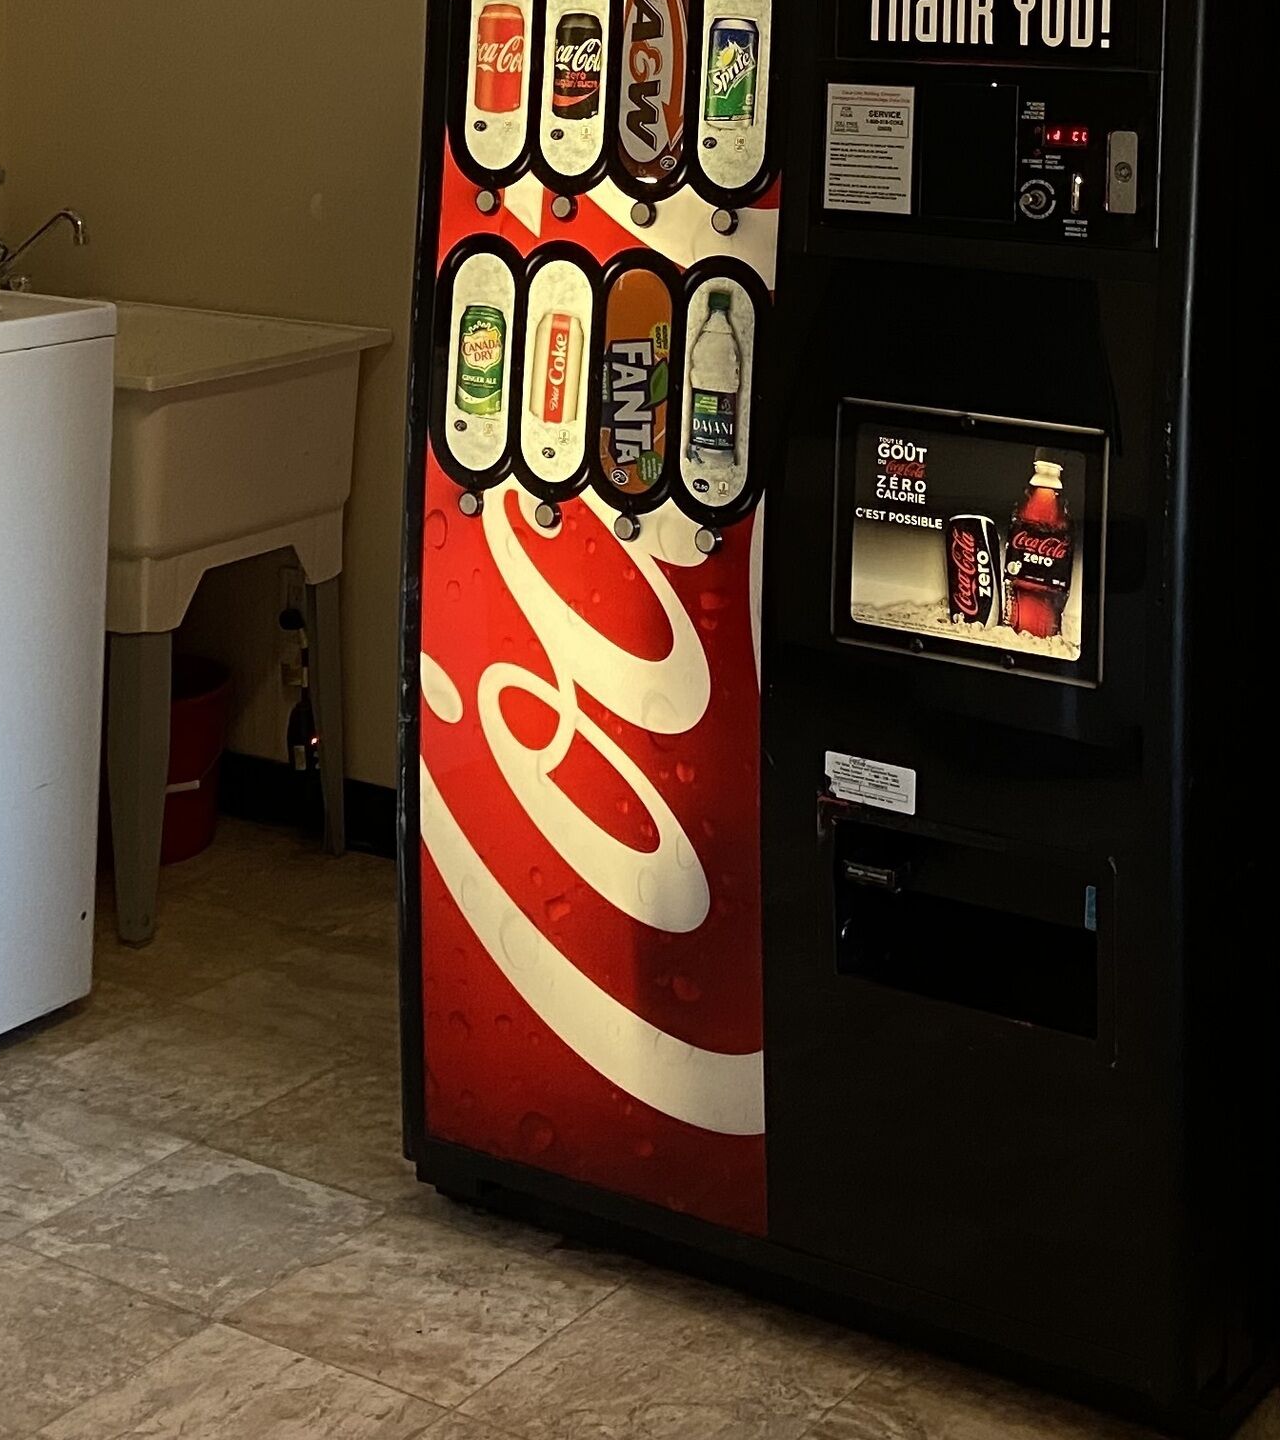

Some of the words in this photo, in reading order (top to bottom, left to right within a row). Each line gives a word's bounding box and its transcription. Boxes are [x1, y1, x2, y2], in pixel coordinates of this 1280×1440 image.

[712, 50, 751, 95] Sprite
[868, 110, 901, 119] SERVICE
[463, 339, 502, 356] CANADA
[474, 350, 493, 362] DRY
[549, 332, 568, 387] Coke
[461, 374, 484, 384] GINGER
[485, 377, 497, 385] ALE
[612, 341, 652, 464] FANTA
[693, 418, 733, 435] DASANI
[877, 443, 927, 463] GOÛT
[876, 474, 927, 492] ZÉRO
[876, 488, 926, 504] CALORIE
[855, 507, 886, 521] C'EST
[888, 512, 942, 530] POSSIBLE
[1012, 530, 1067, 559] Coca-Cola
[1023, 552, 1053, 567] zero
[951, 528, 978, 616] Coca-Cola
[976, 550, 991, 598] zero
